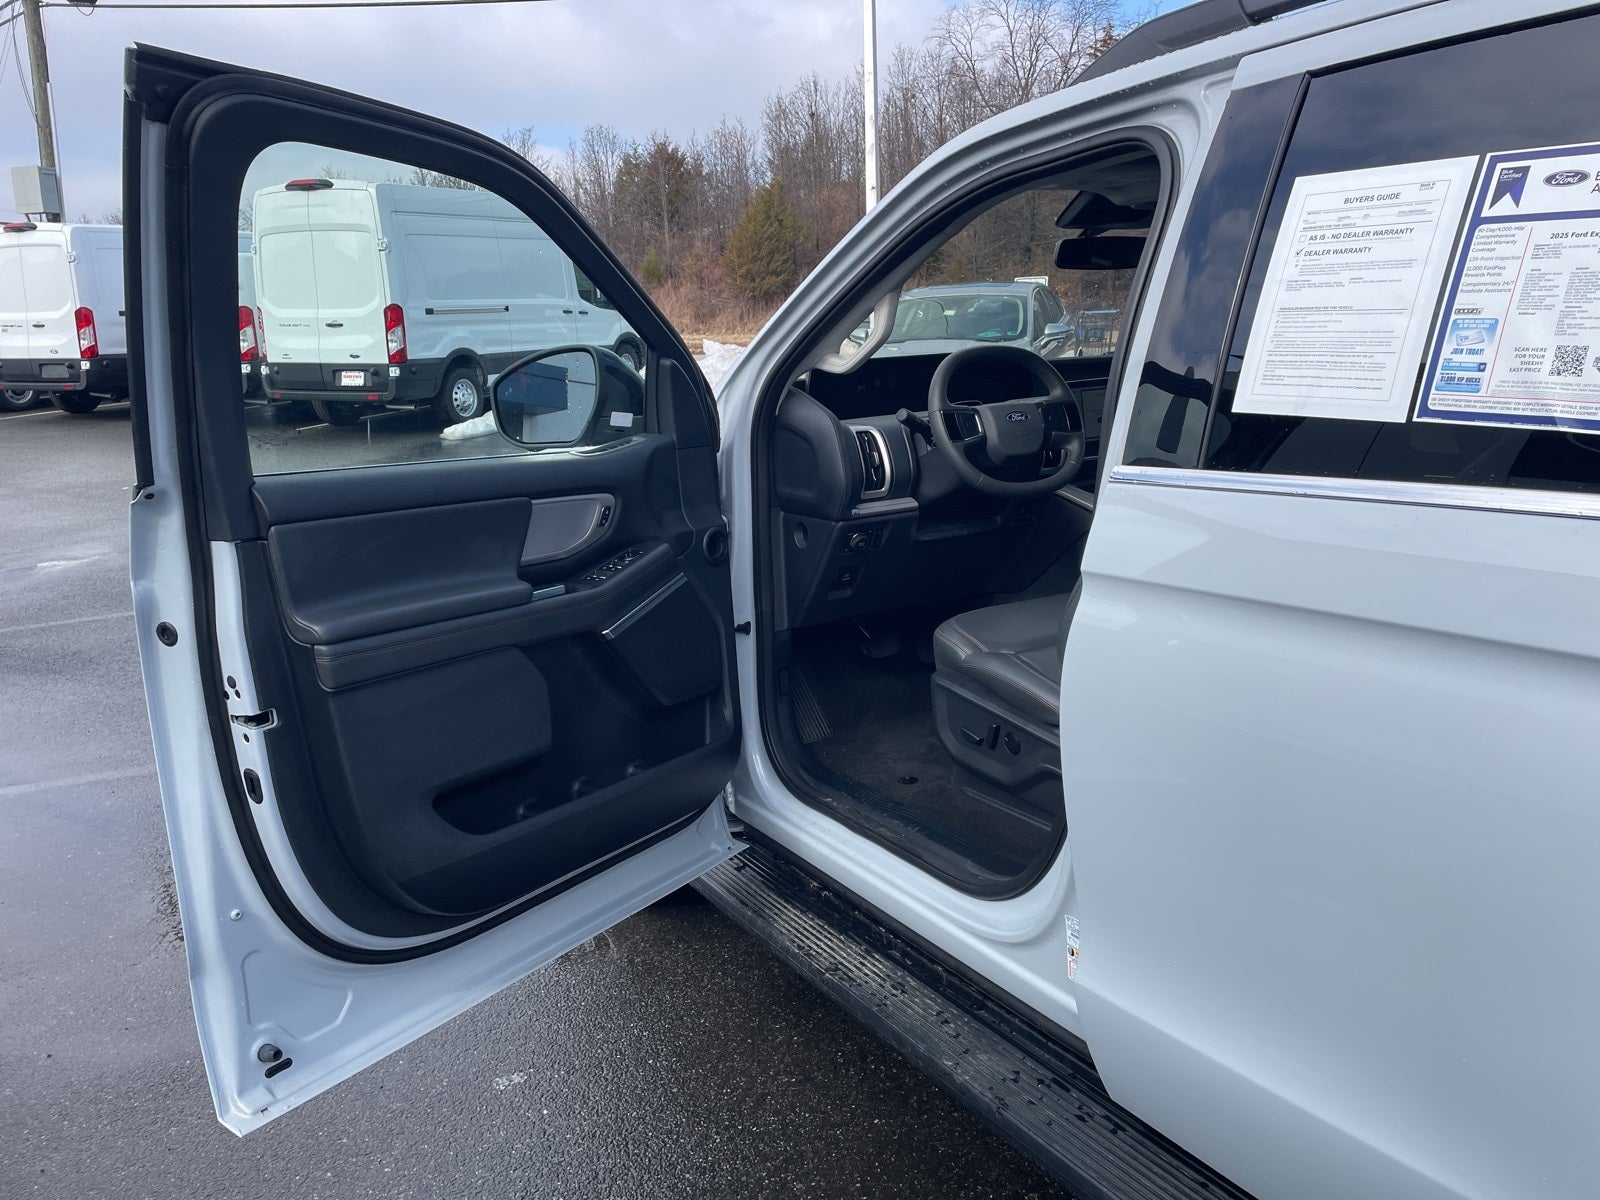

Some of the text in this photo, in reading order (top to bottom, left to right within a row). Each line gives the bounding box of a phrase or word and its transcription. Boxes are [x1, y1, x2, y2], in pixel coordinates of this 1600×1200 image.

[1500, 172, 1522, 180] Certified
[1344, 192, 1402, 205] BUYERS GUIDE
[1308, 234, 1318, 242] AS
[1318, 233, 1326, 241] IS
[1330, 232, 1342, 240] NO
[1342, 230, 1372, 239] DEALER
[1372, 227, 1415, 238] WARRANTY
[1550, 232, 1570, 240] 2025
[1304, 246, 1372, 257] DEALER WARRANTY
[1464, 348, 1484, 356] TODAY!
